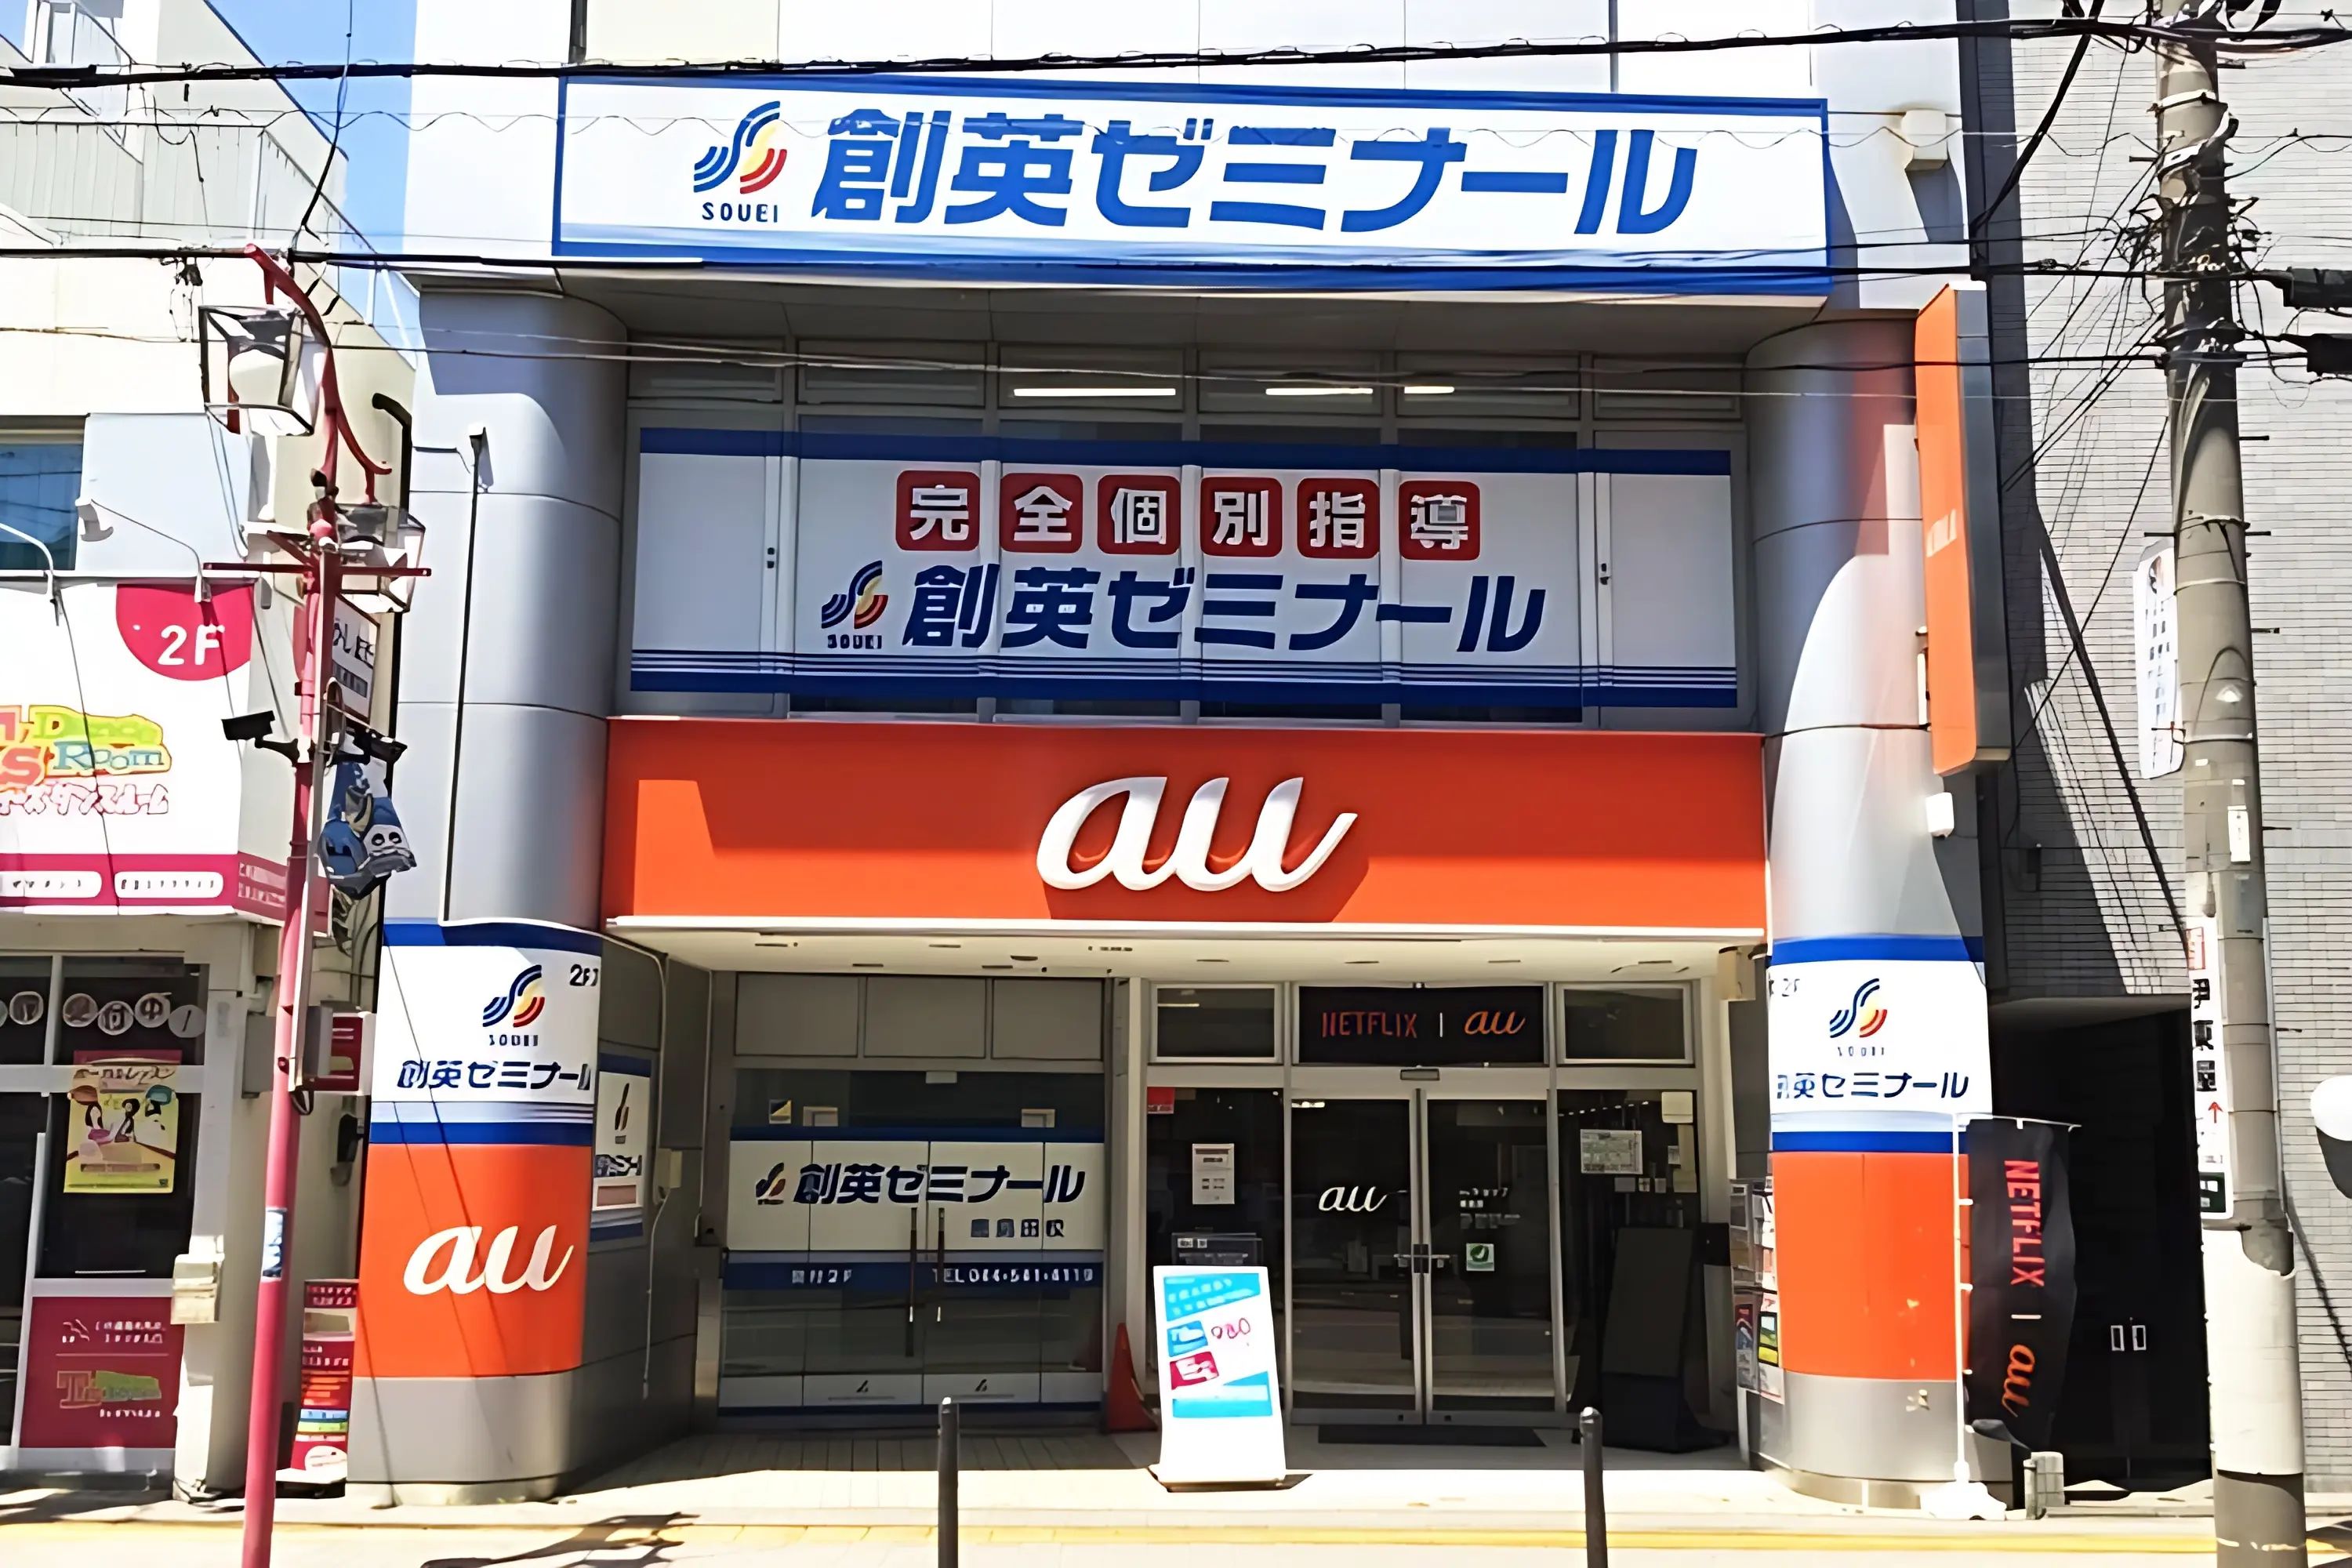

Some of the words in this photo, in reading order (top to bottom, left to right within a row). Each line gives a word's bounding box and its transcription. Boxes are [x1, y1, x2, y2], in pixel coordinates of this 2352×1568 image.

[811, 108, 1696, 235] 創英ゼミナール
[702, 201, 779, 223] SOUEI
[909, 483, 1469, 551] 完全個別指導
[902, 563, 1546, 652] 創英ゼミナール
[157, 624, 224, 665] 2F
[1036, 776, 1358, 892] au
[1464, 1010, 1526, 1035] au
[793, 1163, 1087, 1205] 創英ゼミナール
[1319, 1185, 1389, 1212] au
[2004, 1160, 2045, 1287] NETFLIX
[403, 1224, 574, 1296] au
[2001, 1344, 2036, 1418] au
